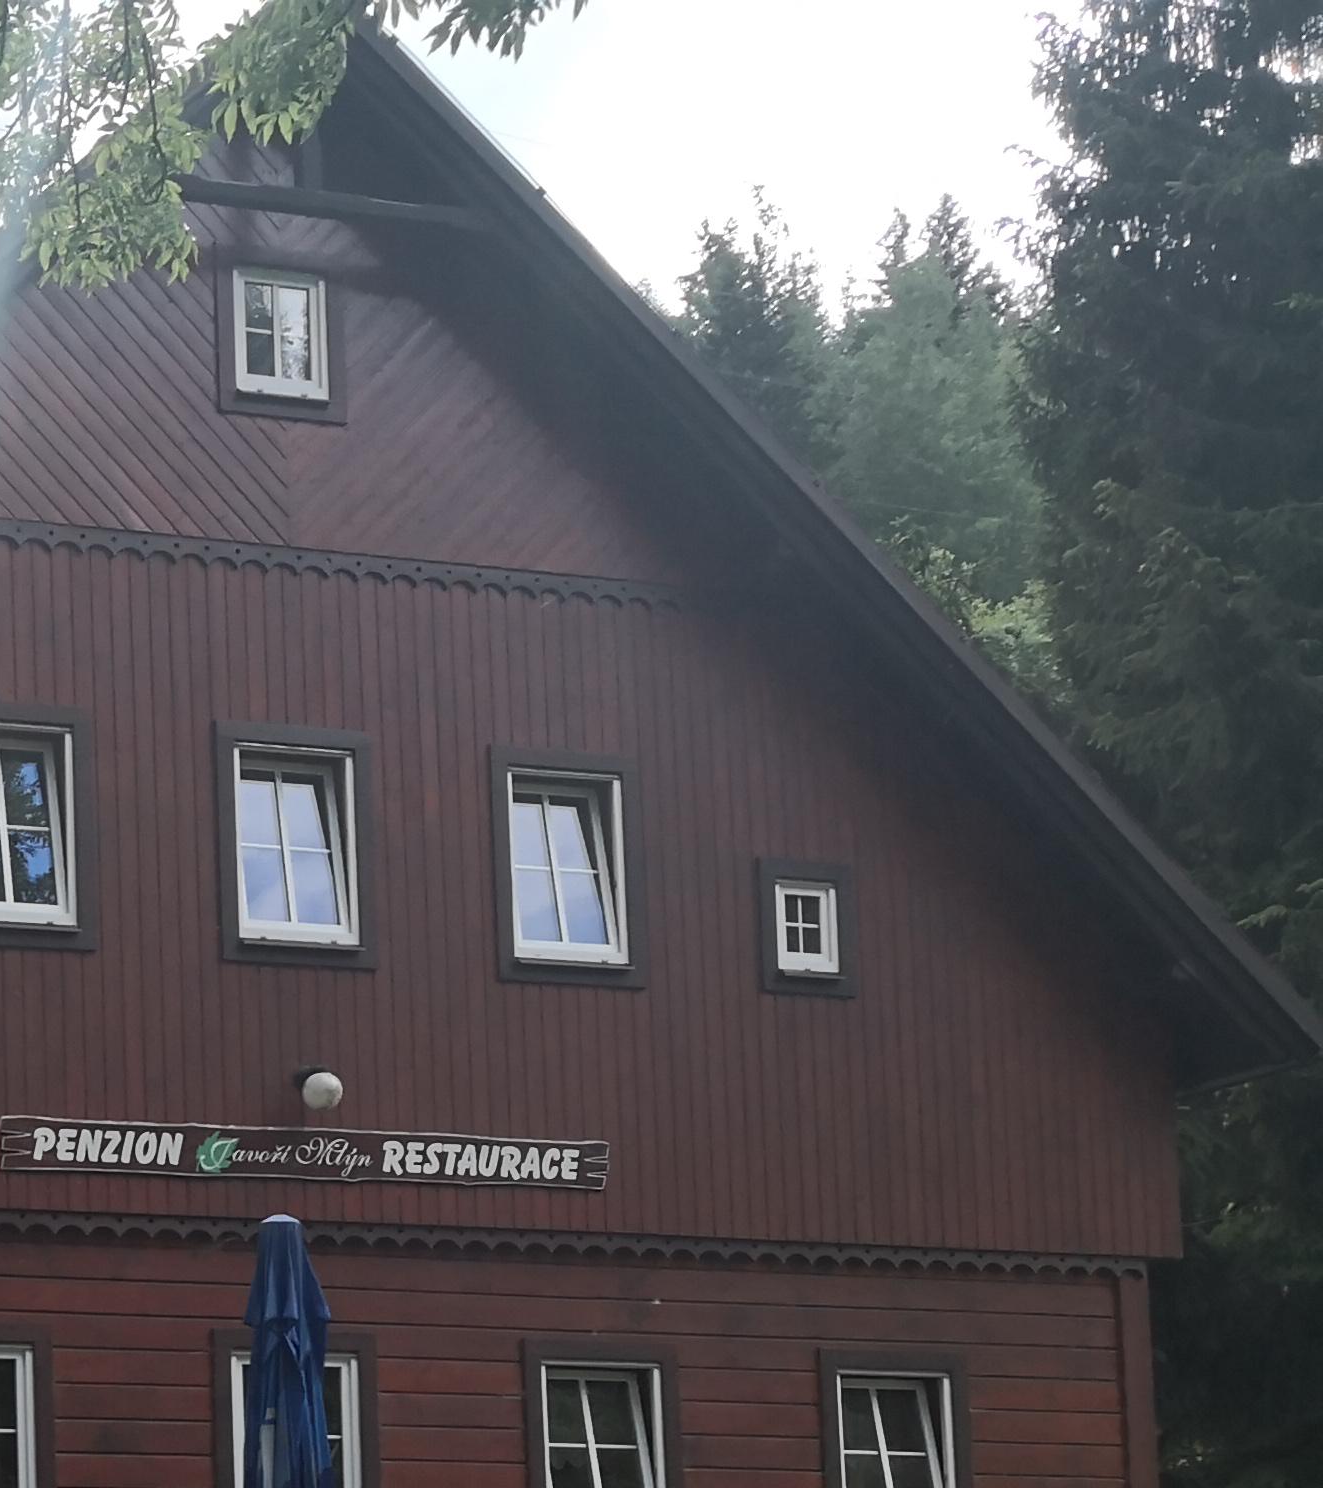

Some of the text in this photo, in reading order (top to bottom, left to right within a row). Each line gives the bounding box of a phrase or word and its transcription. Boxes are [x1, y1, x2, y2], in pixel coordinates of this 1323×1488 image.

[33, 1126, 184, 1166] PENZION
[295, 1138, 373, 1178] Mlýn
[382, 1140, 580, 1181] RESTAURACE
